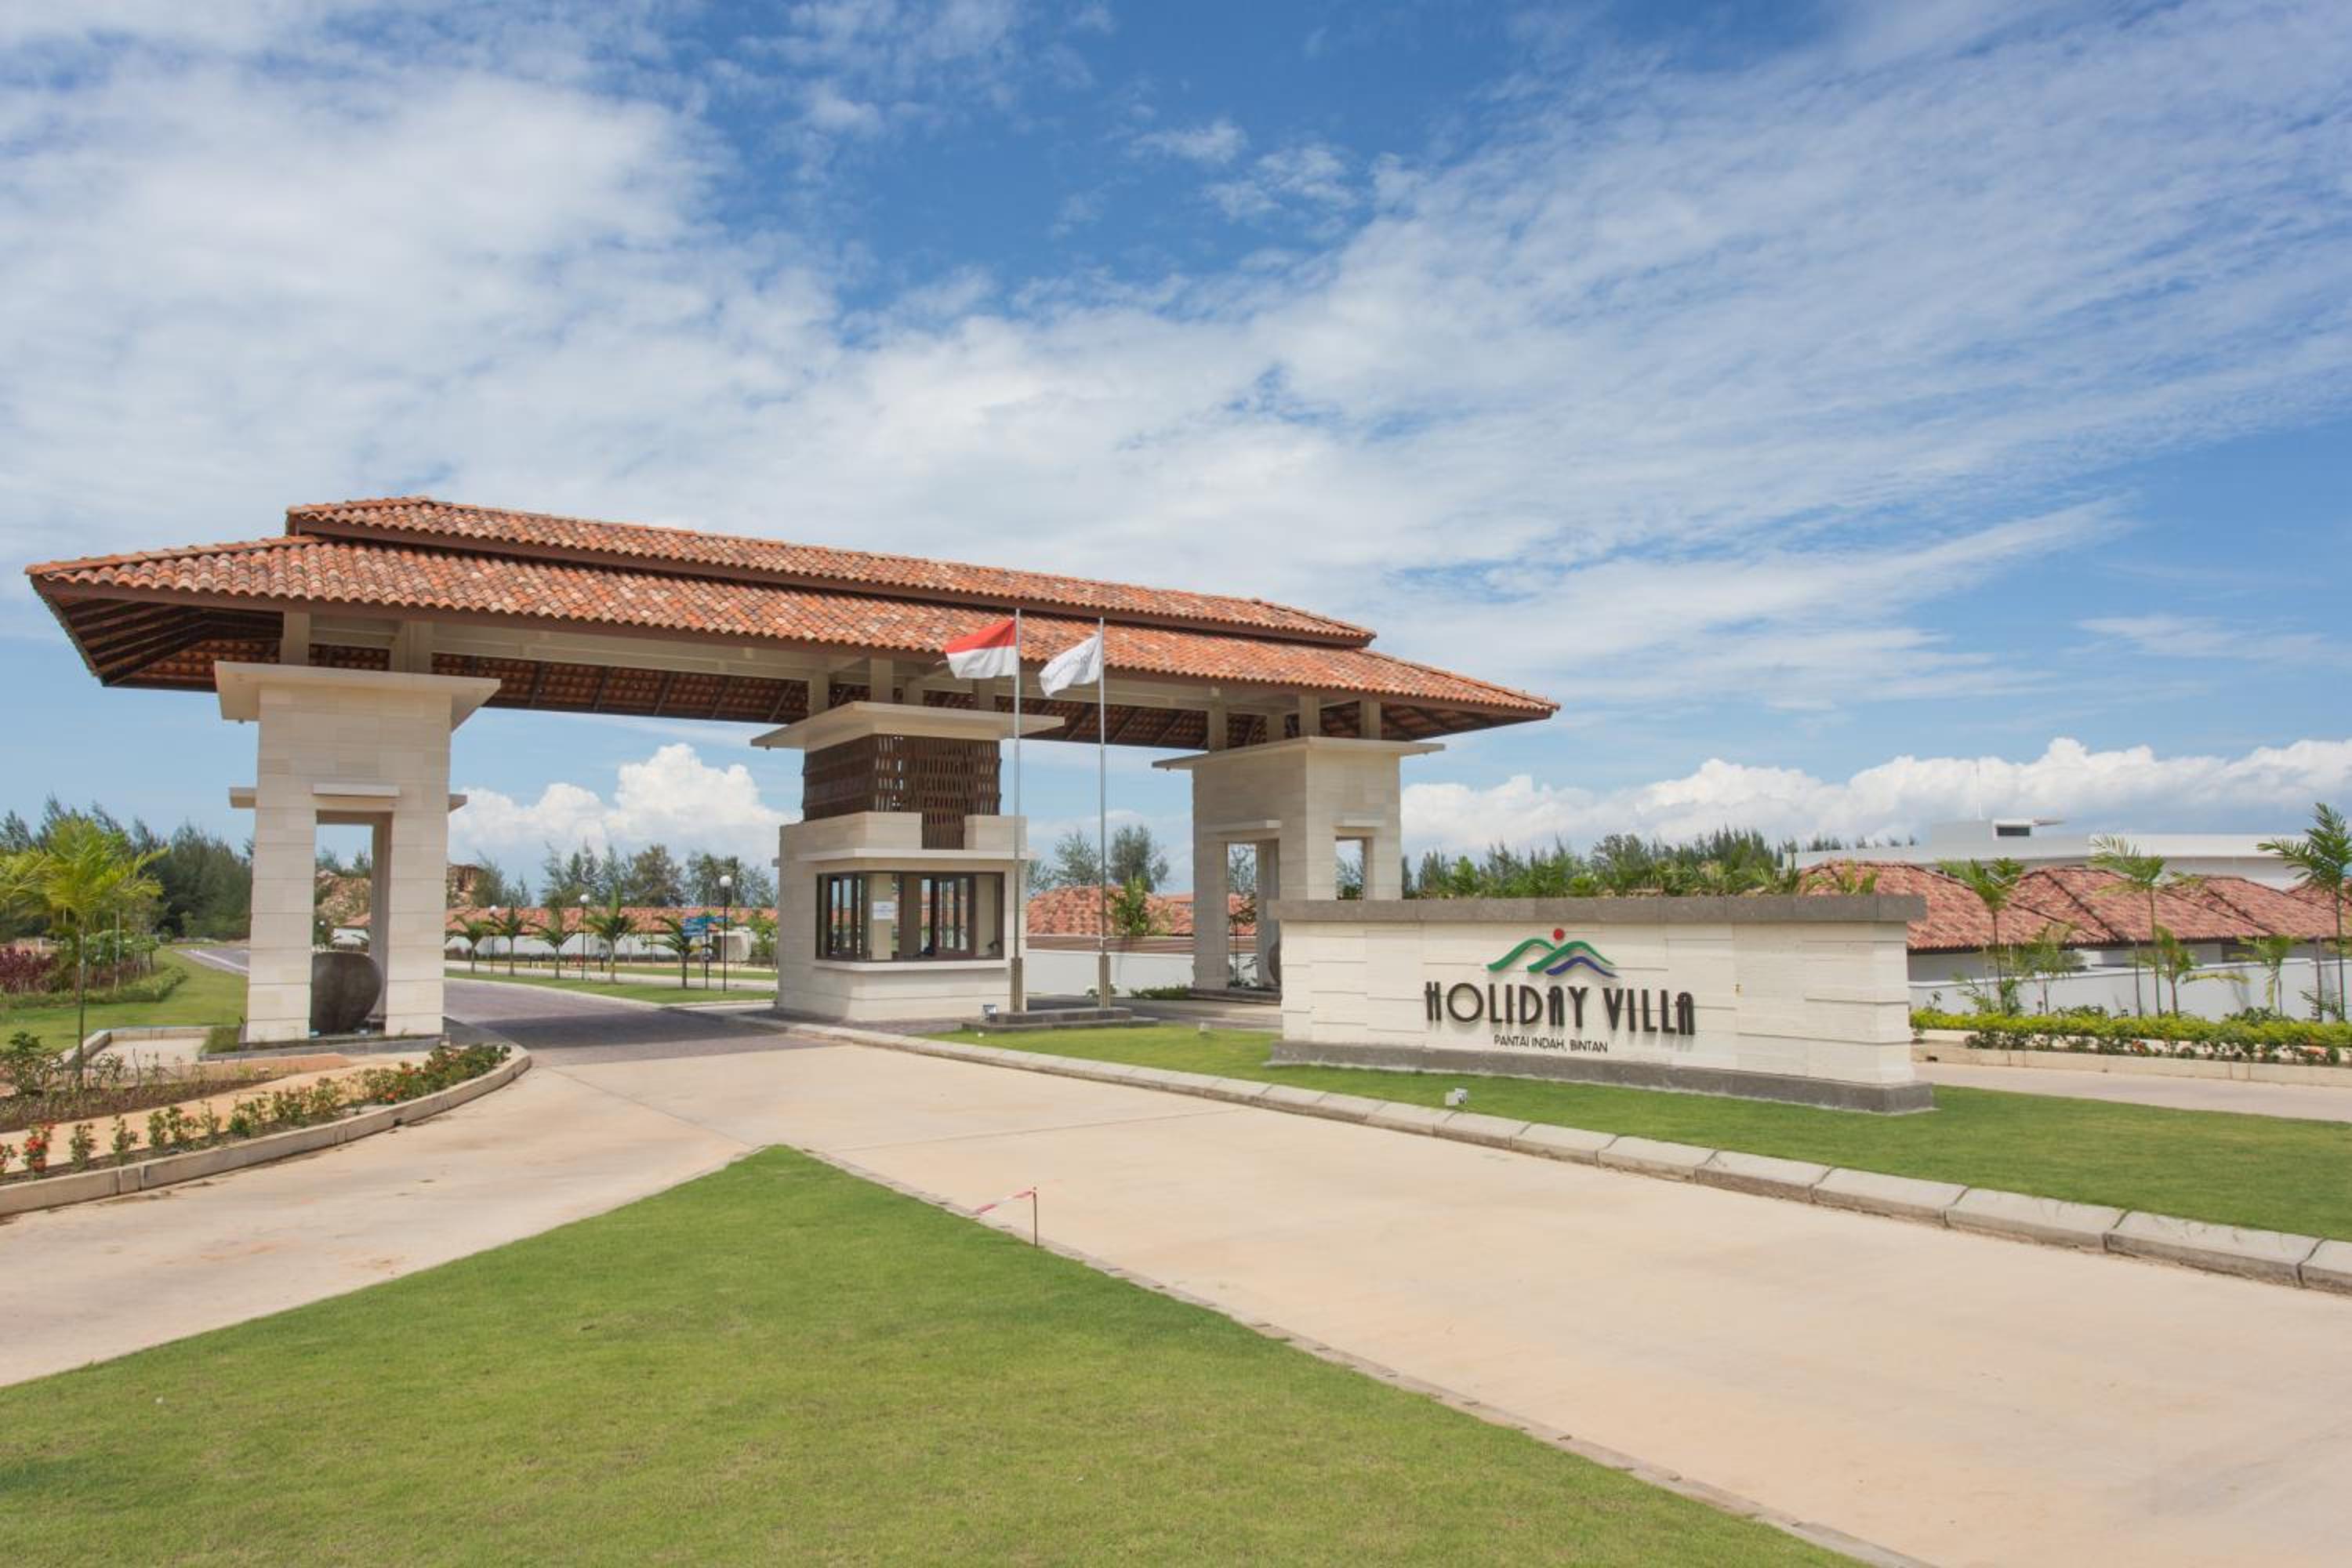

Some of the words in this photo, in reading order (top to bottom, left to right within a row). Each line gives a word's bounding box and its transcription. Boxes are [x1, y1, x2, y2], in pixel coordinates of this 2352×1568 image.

[1425, 982, 1588, 1028] HOLIDAY
[1602, 988, 1695, 1035] VILLA
[1494, 1034, 1529, 1047] PANTAI
[1531, 1036, 1567, 1051] INDAH,
[1570, 1039, 1608, 1052] BINTAN
